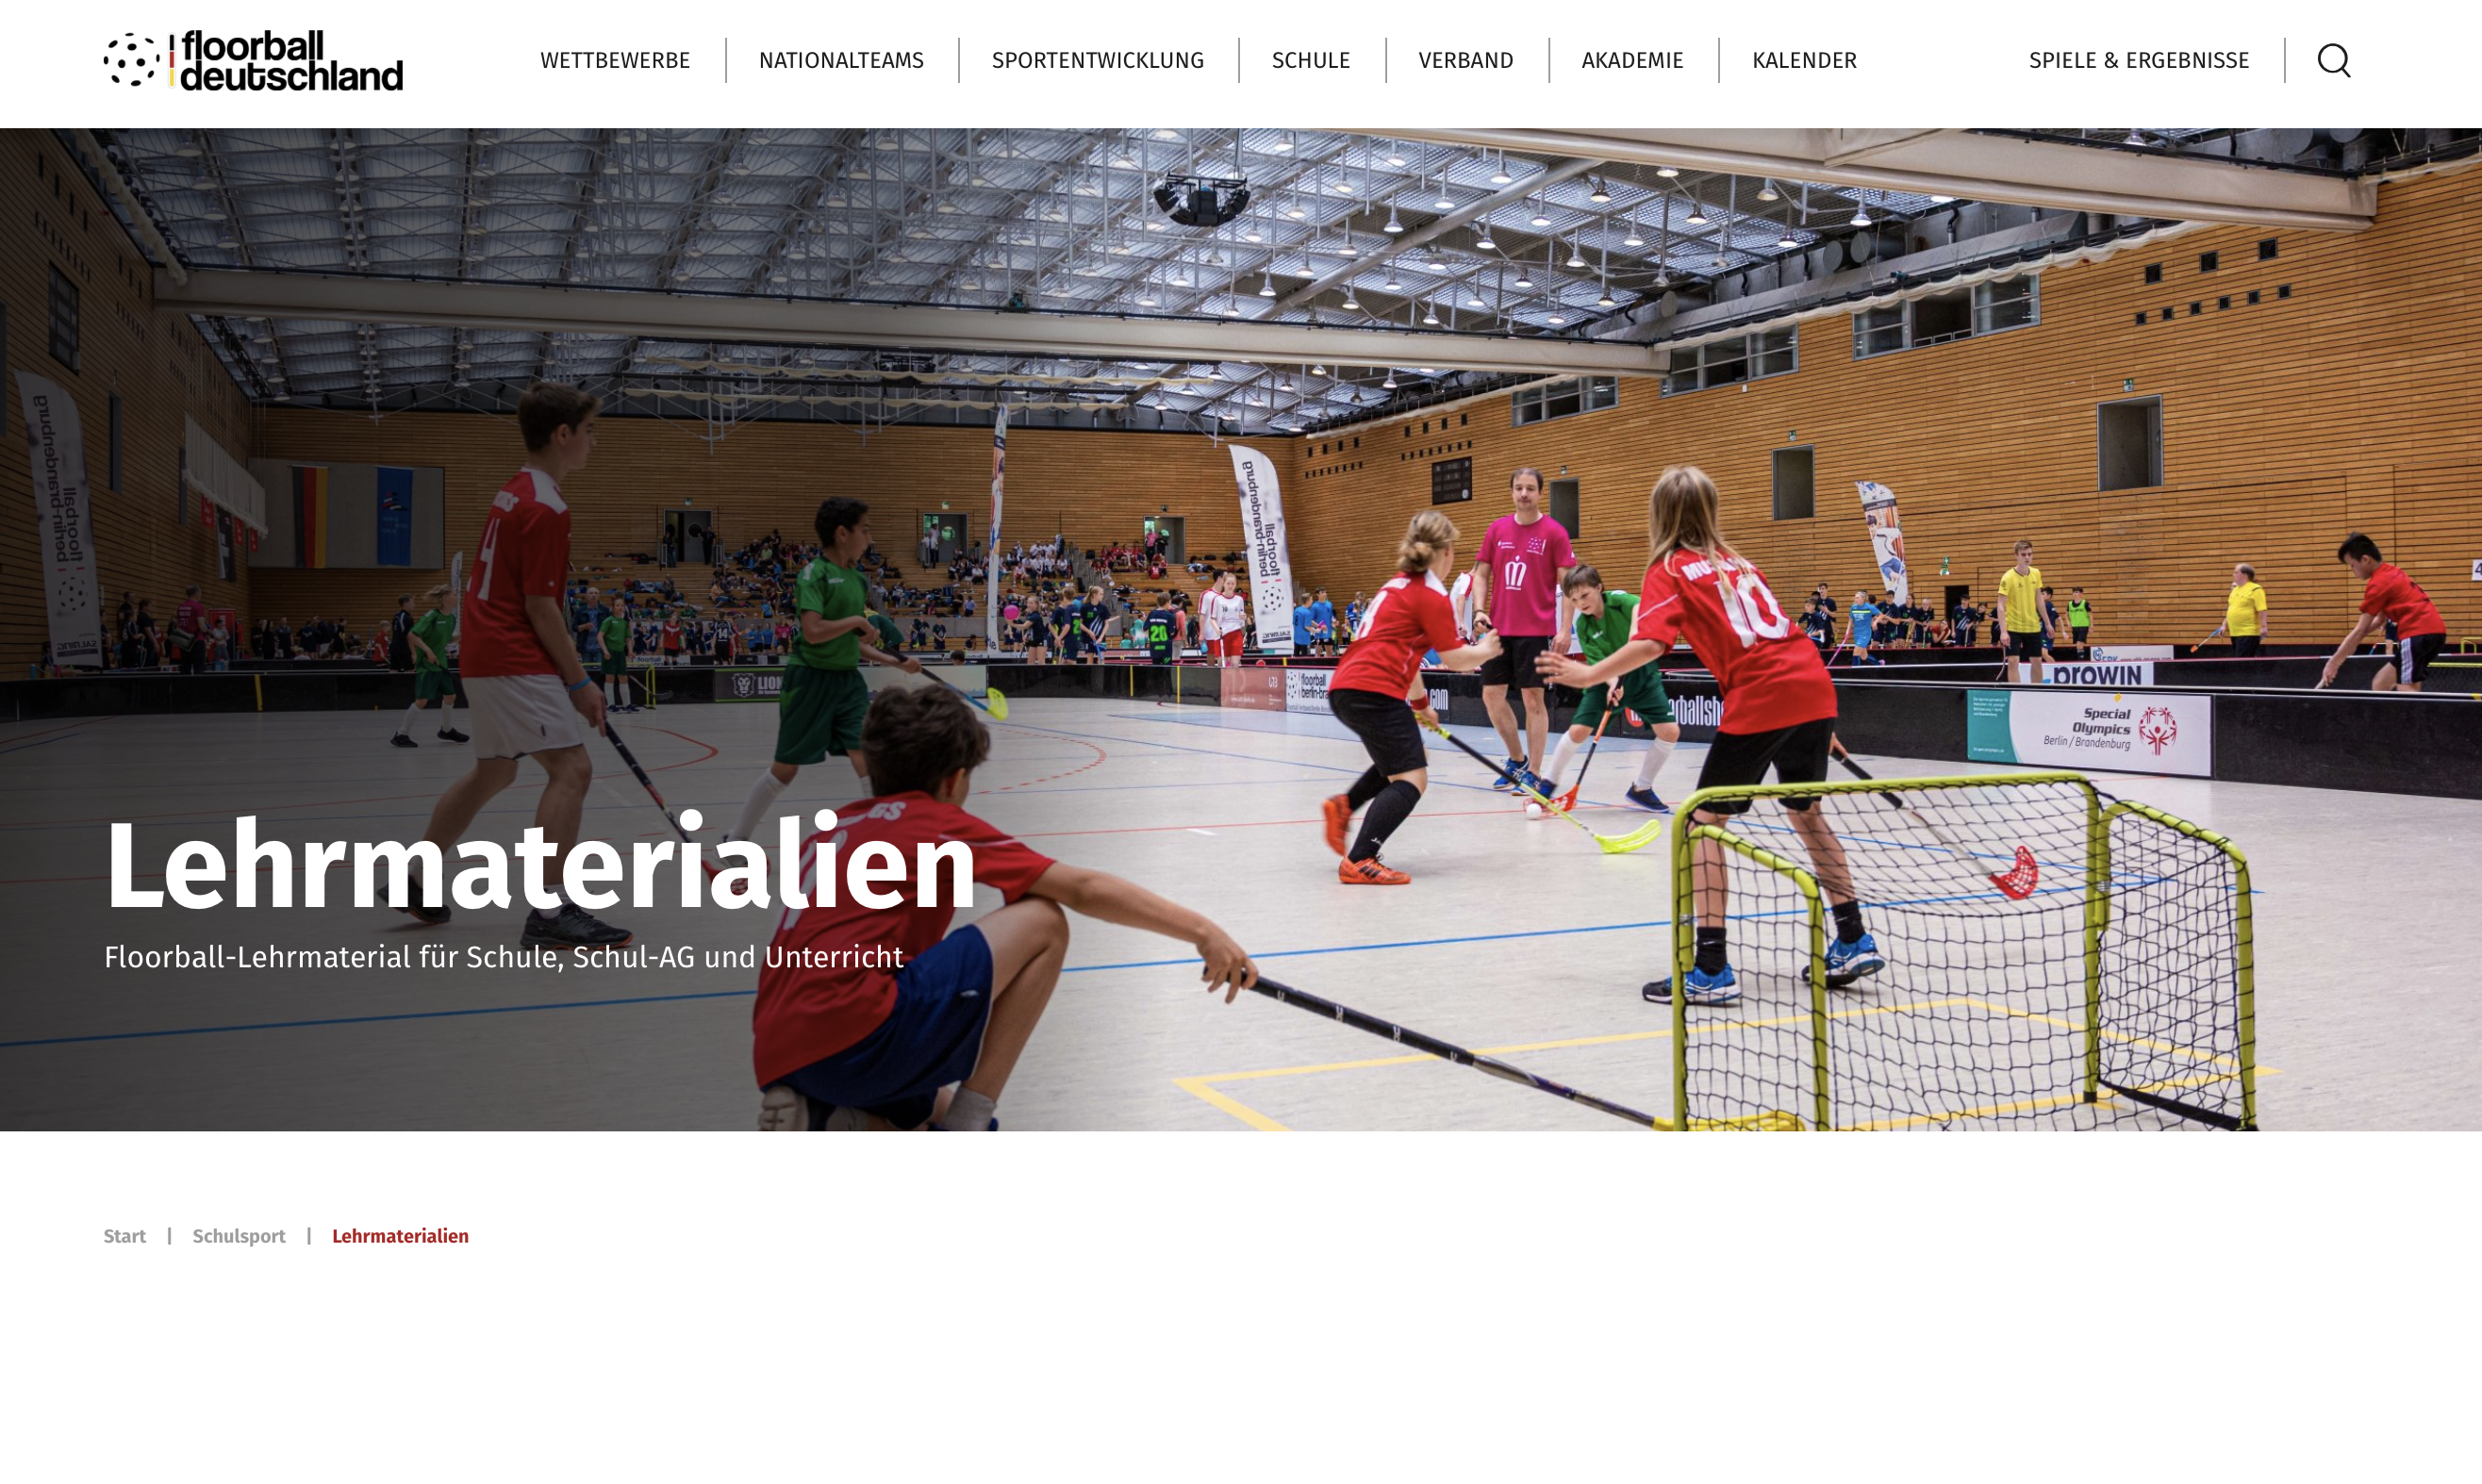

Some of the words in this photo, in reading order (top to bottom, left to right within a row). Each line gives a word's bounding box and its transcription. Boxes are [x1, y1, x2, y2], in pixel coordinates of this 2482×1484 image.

[1713, 569, 1791, 649] 10
[717, 627, 728, 639] 14
[1150, 624, 1168, 642] 20
[1301, 673, 1327, 686] floorball
[1301, 686, 1332, 700] berlin-bra
[2084, 707, 2131, 720] Special
[2073, 721, 2131, 736] Olympics
[2044, 735, 2068, 746] Berlin
[2076, 736, 2131, 751] Brandenburg
